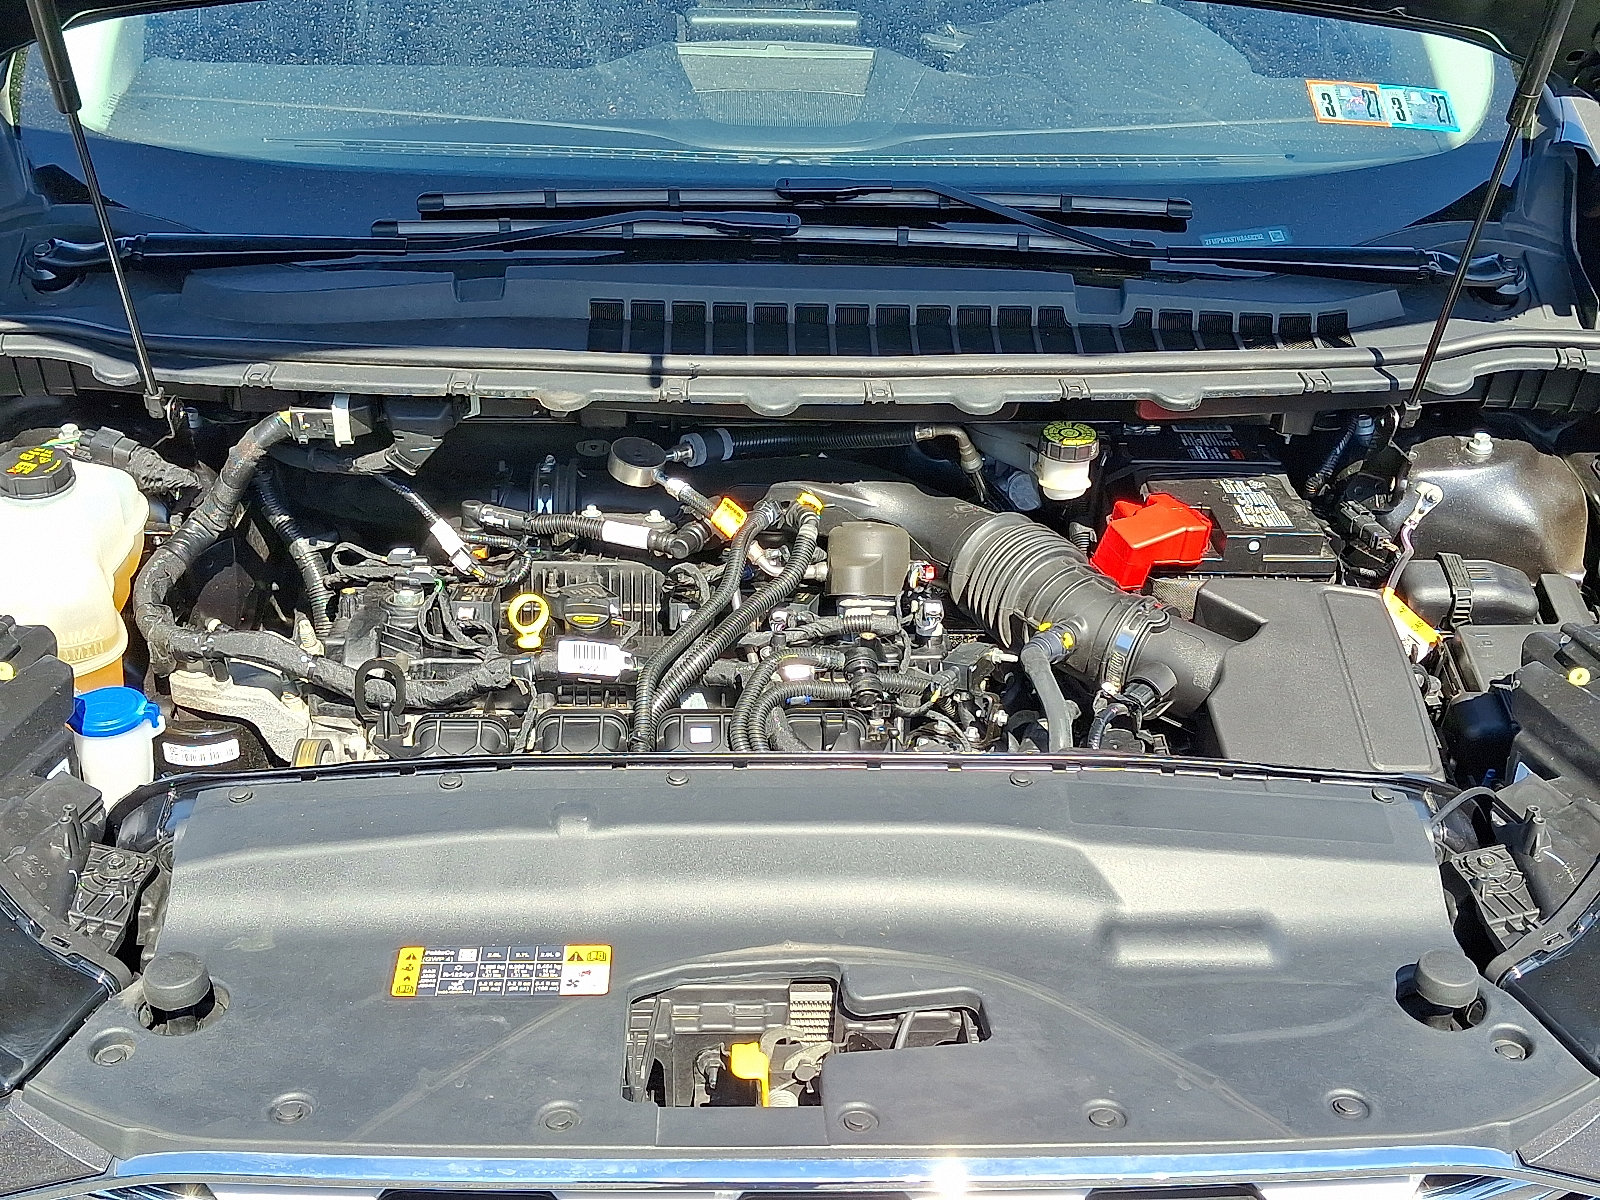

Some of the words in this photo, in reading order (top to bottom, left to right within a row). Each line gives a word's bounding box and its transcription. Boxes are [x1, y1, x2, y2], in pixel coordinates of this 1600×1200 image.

[1321, 92, 1337, 118] 3
[1361, 89, 1382, 120] 27
[1391, 97, 1407, 122] 3
[1431, 94, 1451, 124] 27
[72, 641, 104, 662] MIN
